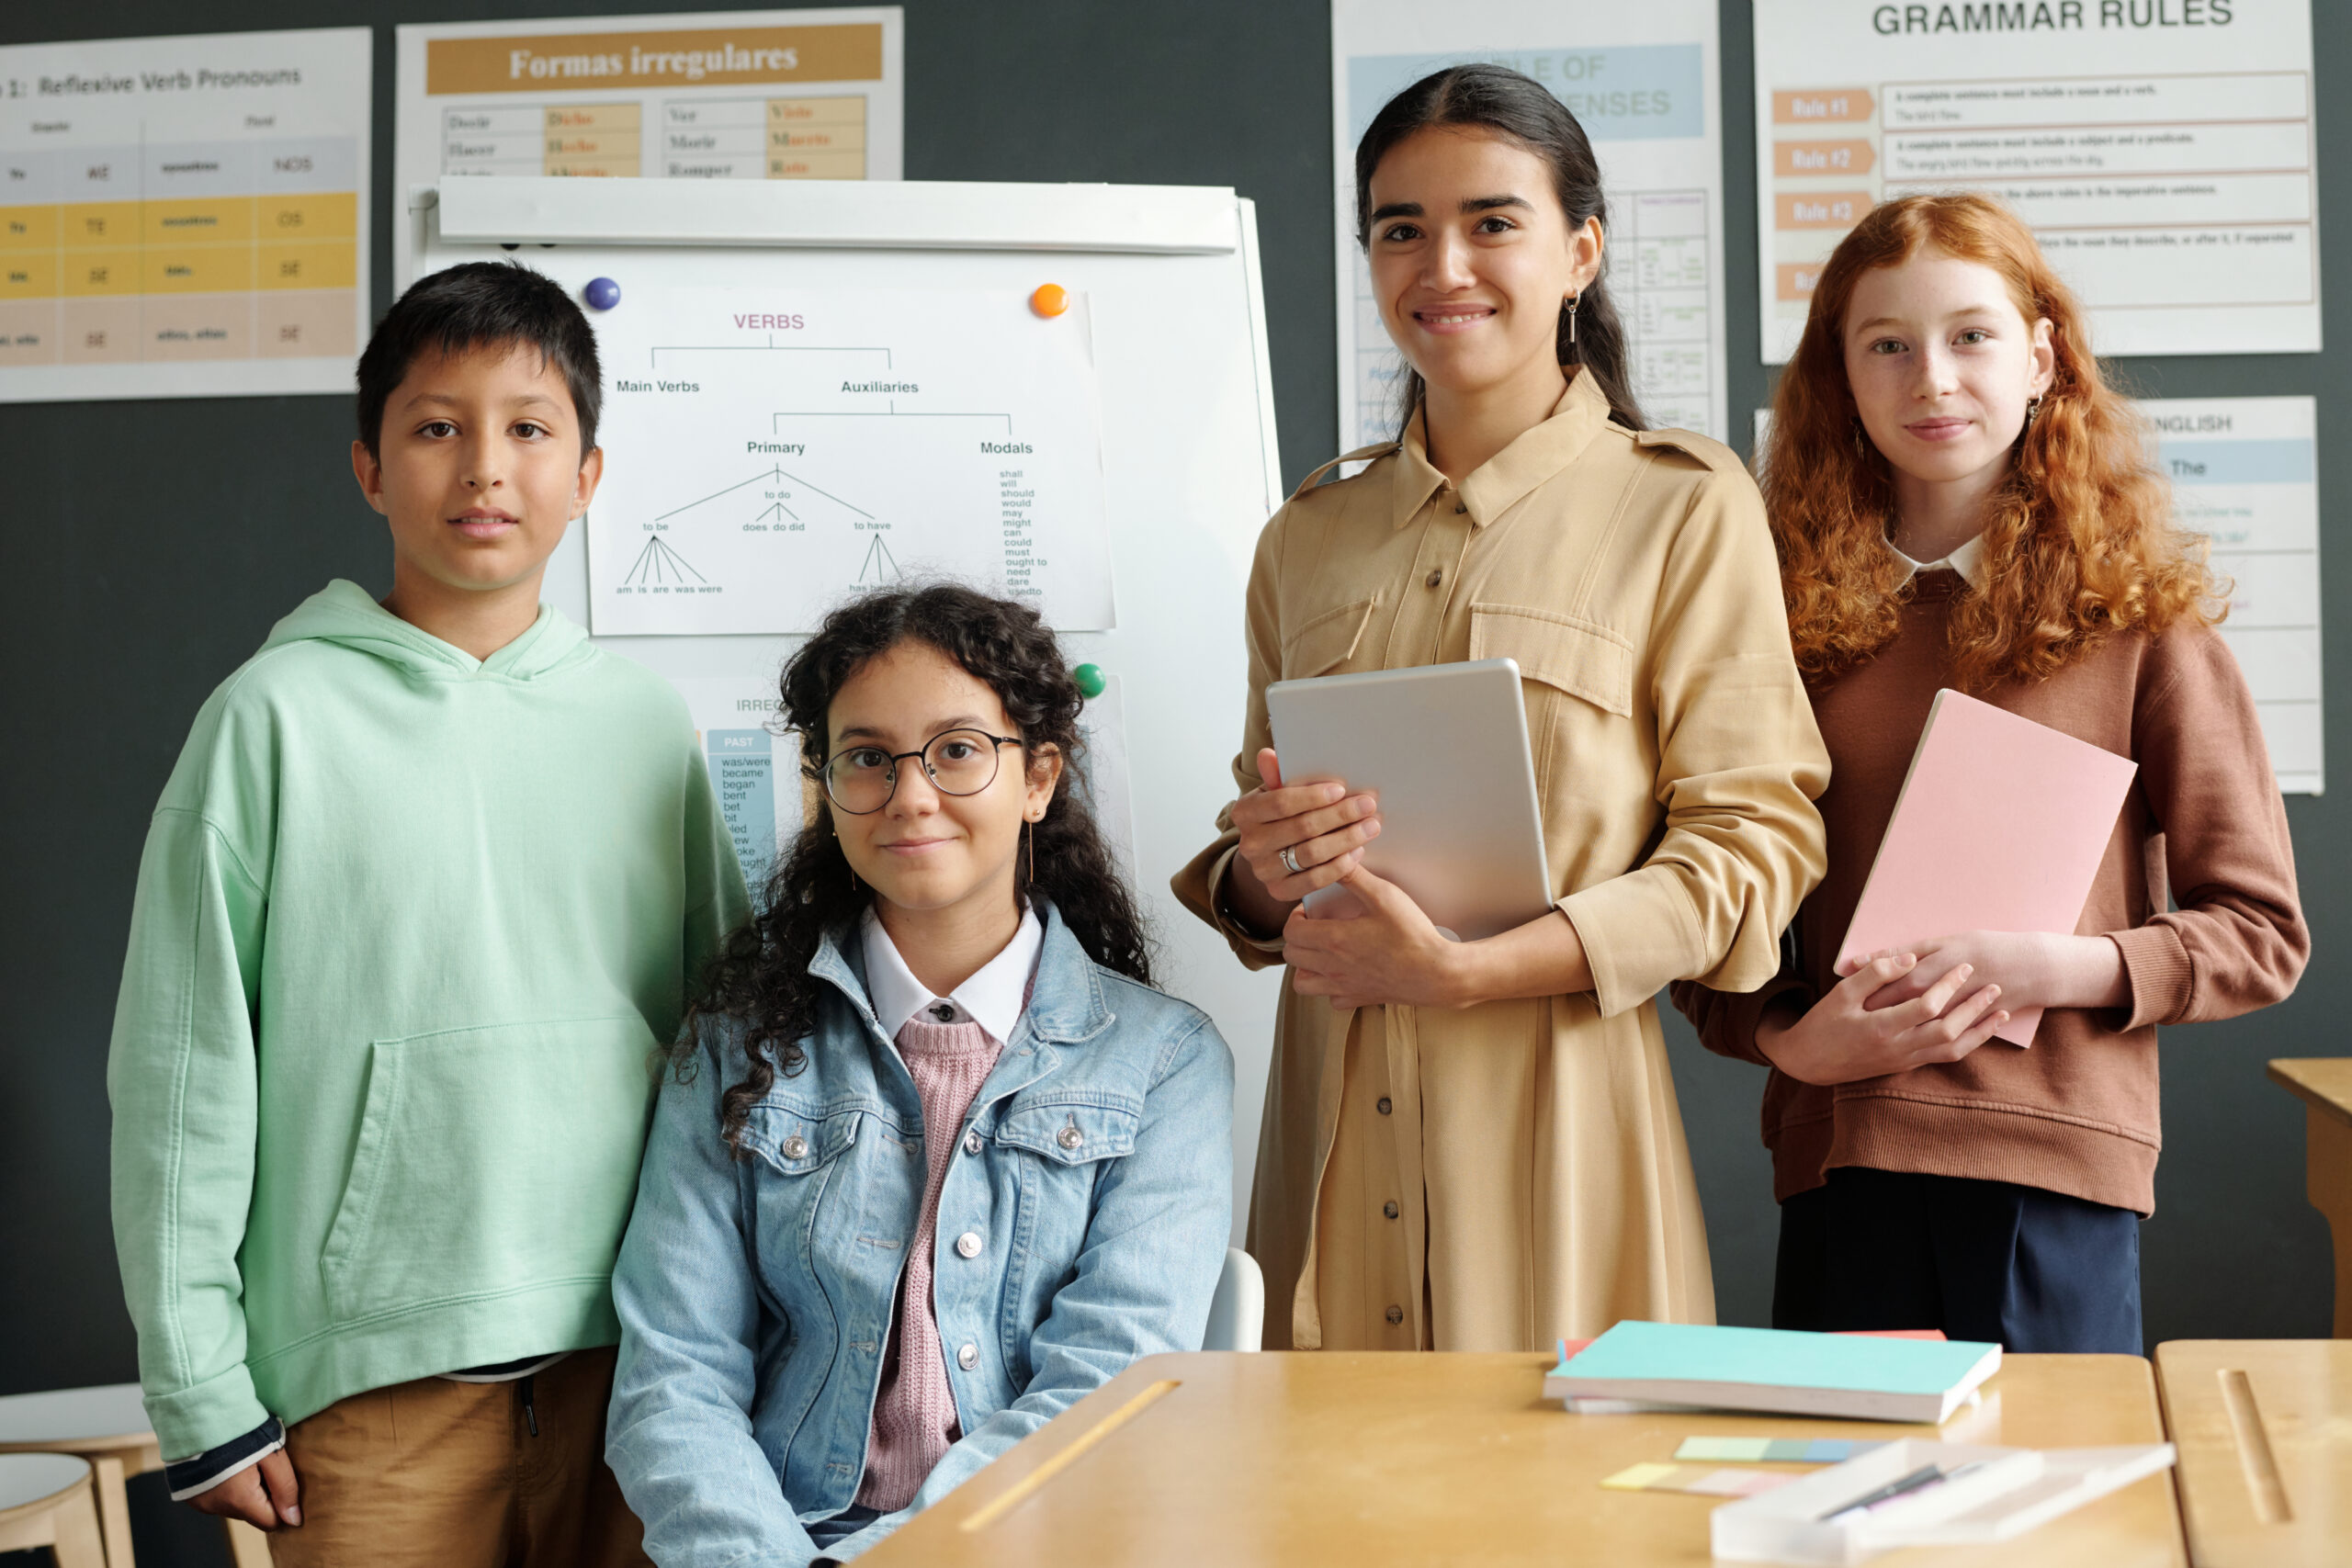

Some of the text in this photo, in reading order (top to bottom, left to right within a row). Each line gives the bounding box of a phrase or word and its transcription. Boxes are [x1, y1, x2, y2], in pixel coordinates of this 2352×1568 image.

[1872, 0, 2233, 34] GRAMMAR RULES
[510, 42, 798, 81] Formas irregulares
[1563, 55, 1605, 81] OF
[38, 73, 135, 97] Reflexive
[141, 70, 191, 92] Verb
[198, 67, 301, 89] Pronouns
[1562, 90, 1670, 117] ENSES
[1792, 96, 1849, 118] Rule #1
[1792, 148, 1850, 169] Rule #2
[274, 155, 313, 174] NOS
[1793, 201, 1828, 221] Rule
[277, 209, 303, 229] OS
[733, 314, 805, 330] VERBS
[617, 380, 699, 392] Main Verbs
[842, 381, 919, 392] Auxiliaries
[2154, 414, 2233, 433] NGLISH
[748, 442, 805, 456] Primary
[981, 442, 1033, 454] Modals
[2171, 457, 2208, 478] The
[1000, 479, 1017, 488] will
[778, 491, 790, 499] do
[1002, 510, 1023, 519] may
[655, 522, 669, 531] be
[742, 522, 805, 531] does do did
[867, 521, 891, 530] have
[1003, 519, 1031, 528] might
[1004, 538, 1032, 547] could
[1005, 558, 1035, 569] ought
[1007, 568, 1031, 576] need
[1007, 578, 1029, 586] dare
[616, 586, 632, 594] am
[724, 737, 753, 747] PAST
[722, 758, 771, 767] was/were
[722, 768, 763, 778] became
[723, 781, 756, 790] began
[723, 791, 746, 801] bent
[724, 802, 740, 812] bet
[725, 813, 737, 822] bit
[729, 824, 747, 834] led
[735, 837, 750, 845] ew
[736, 847, 755, 856] oke
[741, 858, 765, 869] ught
